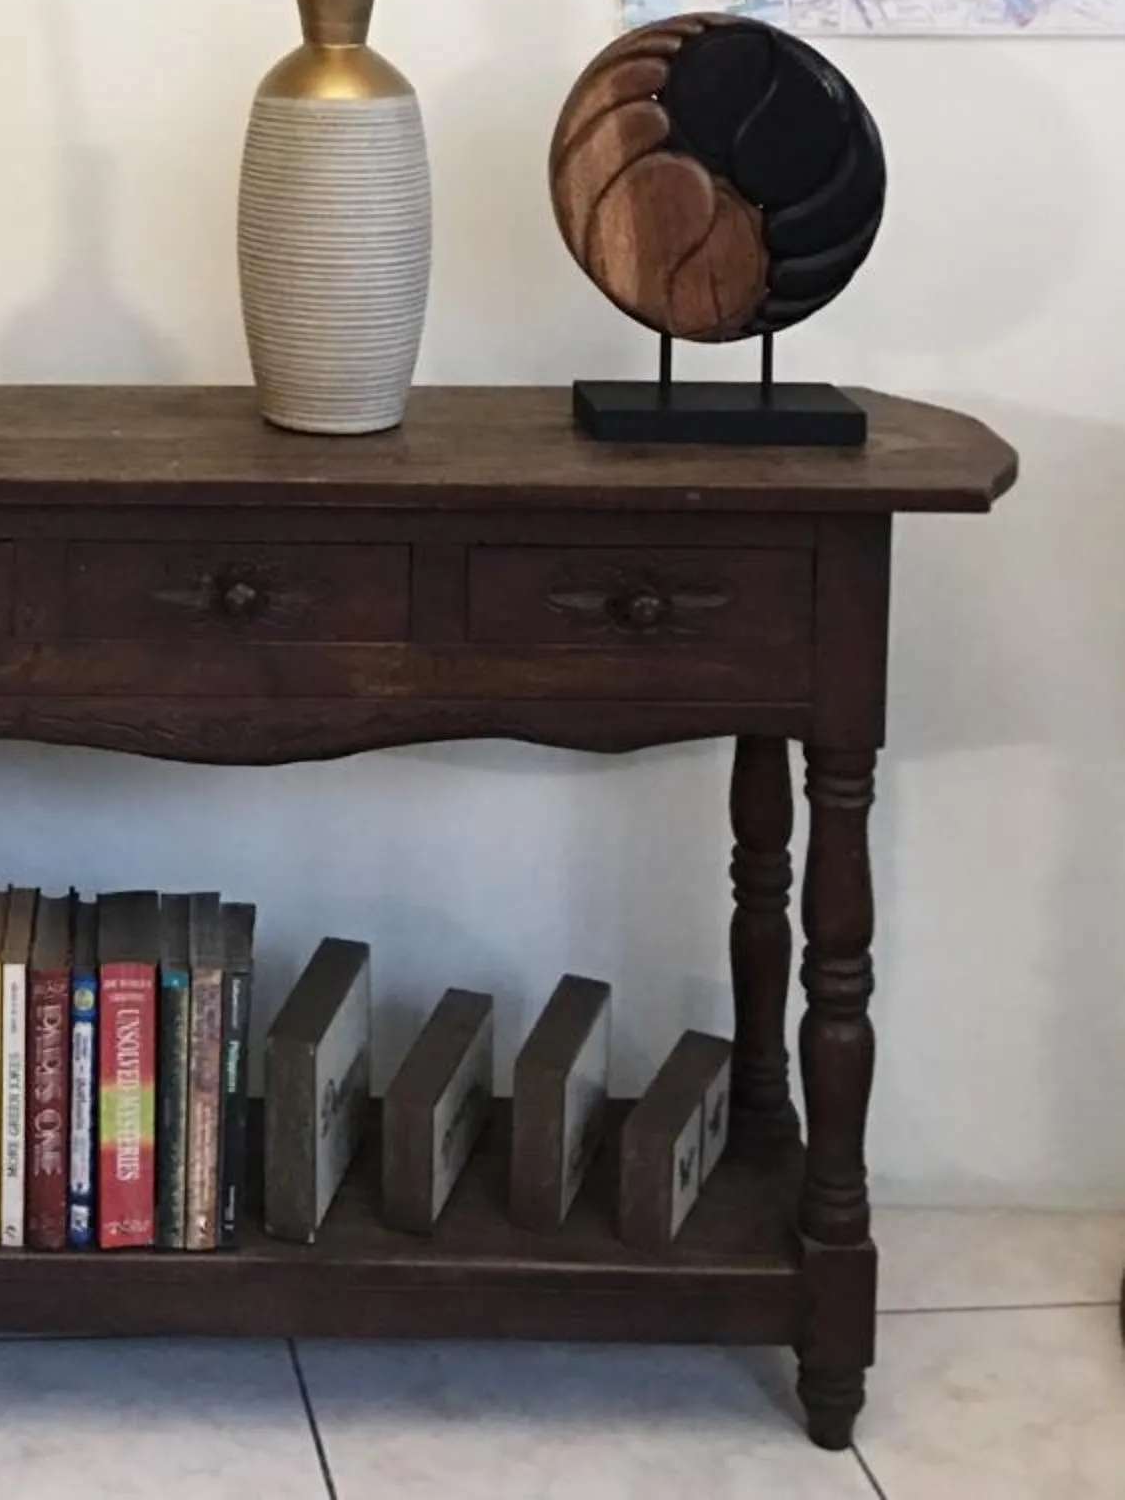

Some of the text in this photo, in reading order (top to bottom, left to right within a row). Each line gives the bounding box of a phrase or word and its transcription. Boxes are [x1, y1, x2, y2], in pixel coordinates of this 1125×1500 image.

[116, 1008, 140, 1090] UNSOLVED
[34, 1108, 62, 1178] ONE
[115, 1095, 140, 1181] MYSTERIES
